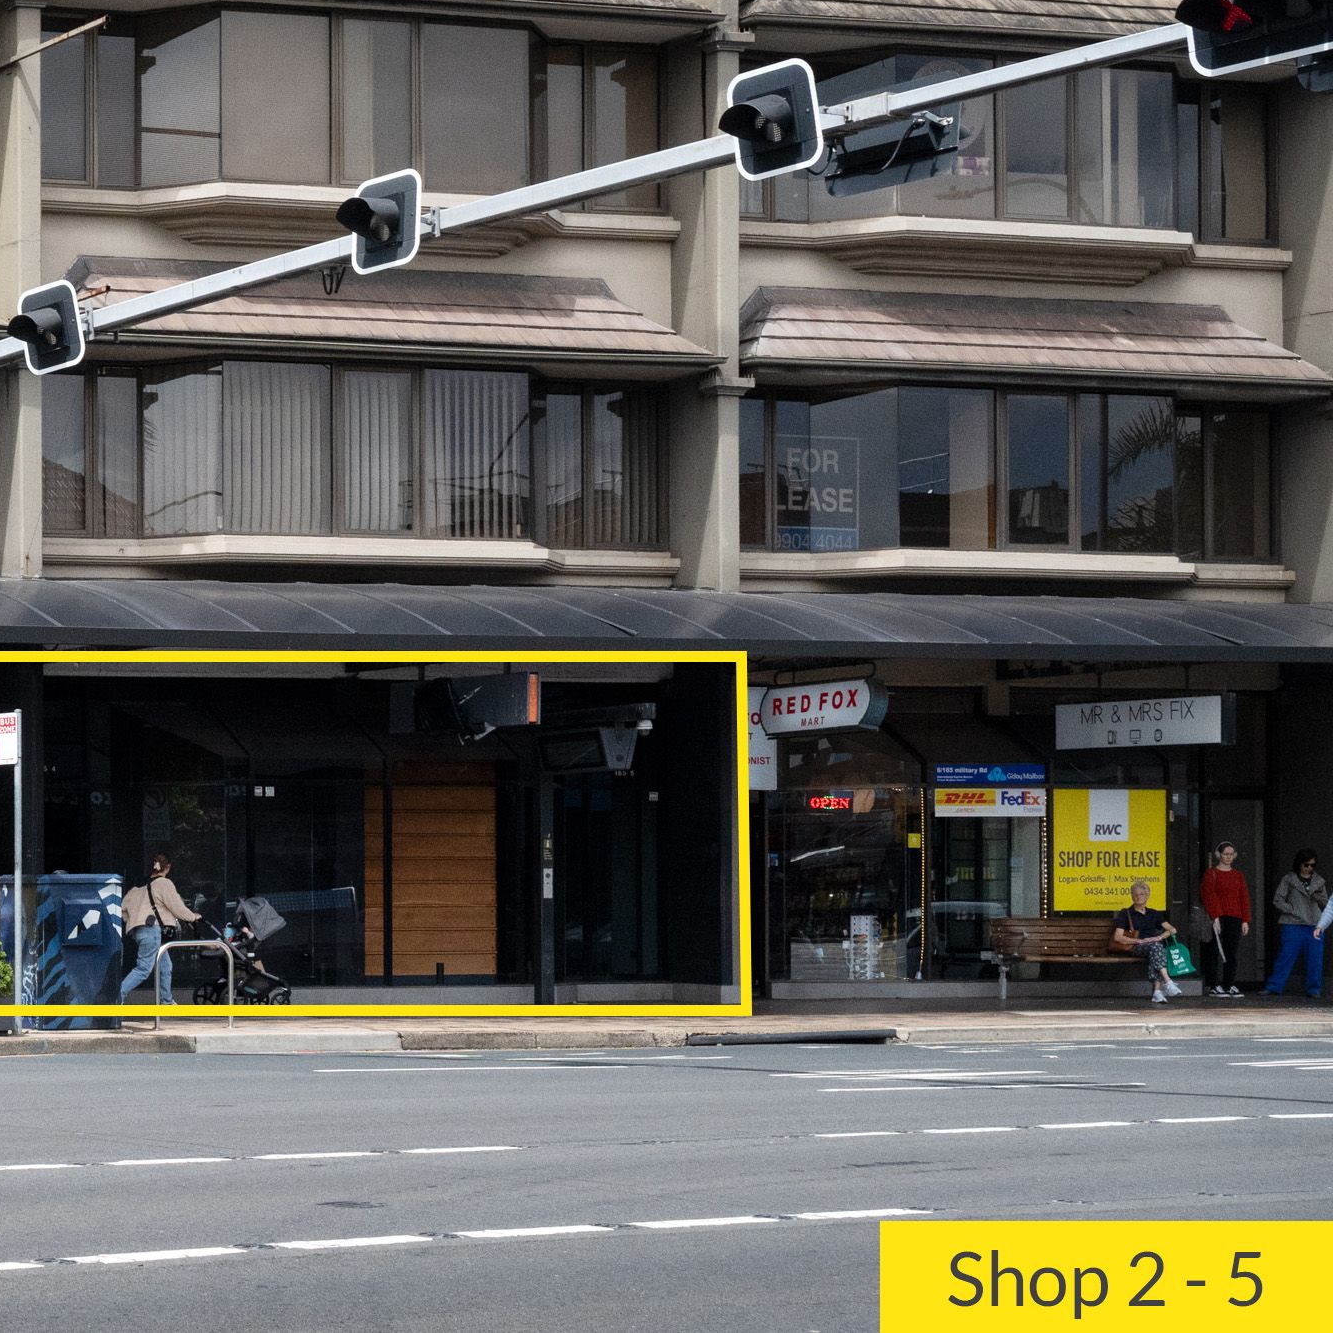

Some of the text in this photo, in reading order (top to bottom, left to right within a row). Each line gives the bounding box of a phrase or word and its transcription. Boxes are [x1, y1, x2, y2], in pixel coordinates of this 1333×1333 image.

[787, 447, 839, 474] FOR
[772, 689, 859, 716] RED FOX
[1080, 700, 1195, 724] MR & MRS FIX
[0, 717, 15, 726] BUS
[800, 716, 825, 726] MART
[809, 797, 851, 809] OPEN
[943, 793, 988, 804] DHL
[1001, 790, 1040, 805] FedEx
[1094, 824, 1122, 835] RWC
[1058, 851, 1161, 868] SHOP FOR LEASE
[1058, 875, 1079, 884] Logan
[1079, 874, 1106, 883] Grisaffe
[1114, 875, 1129, 883] Max
[1084, 887, 1132, 896] 0434 341 00
